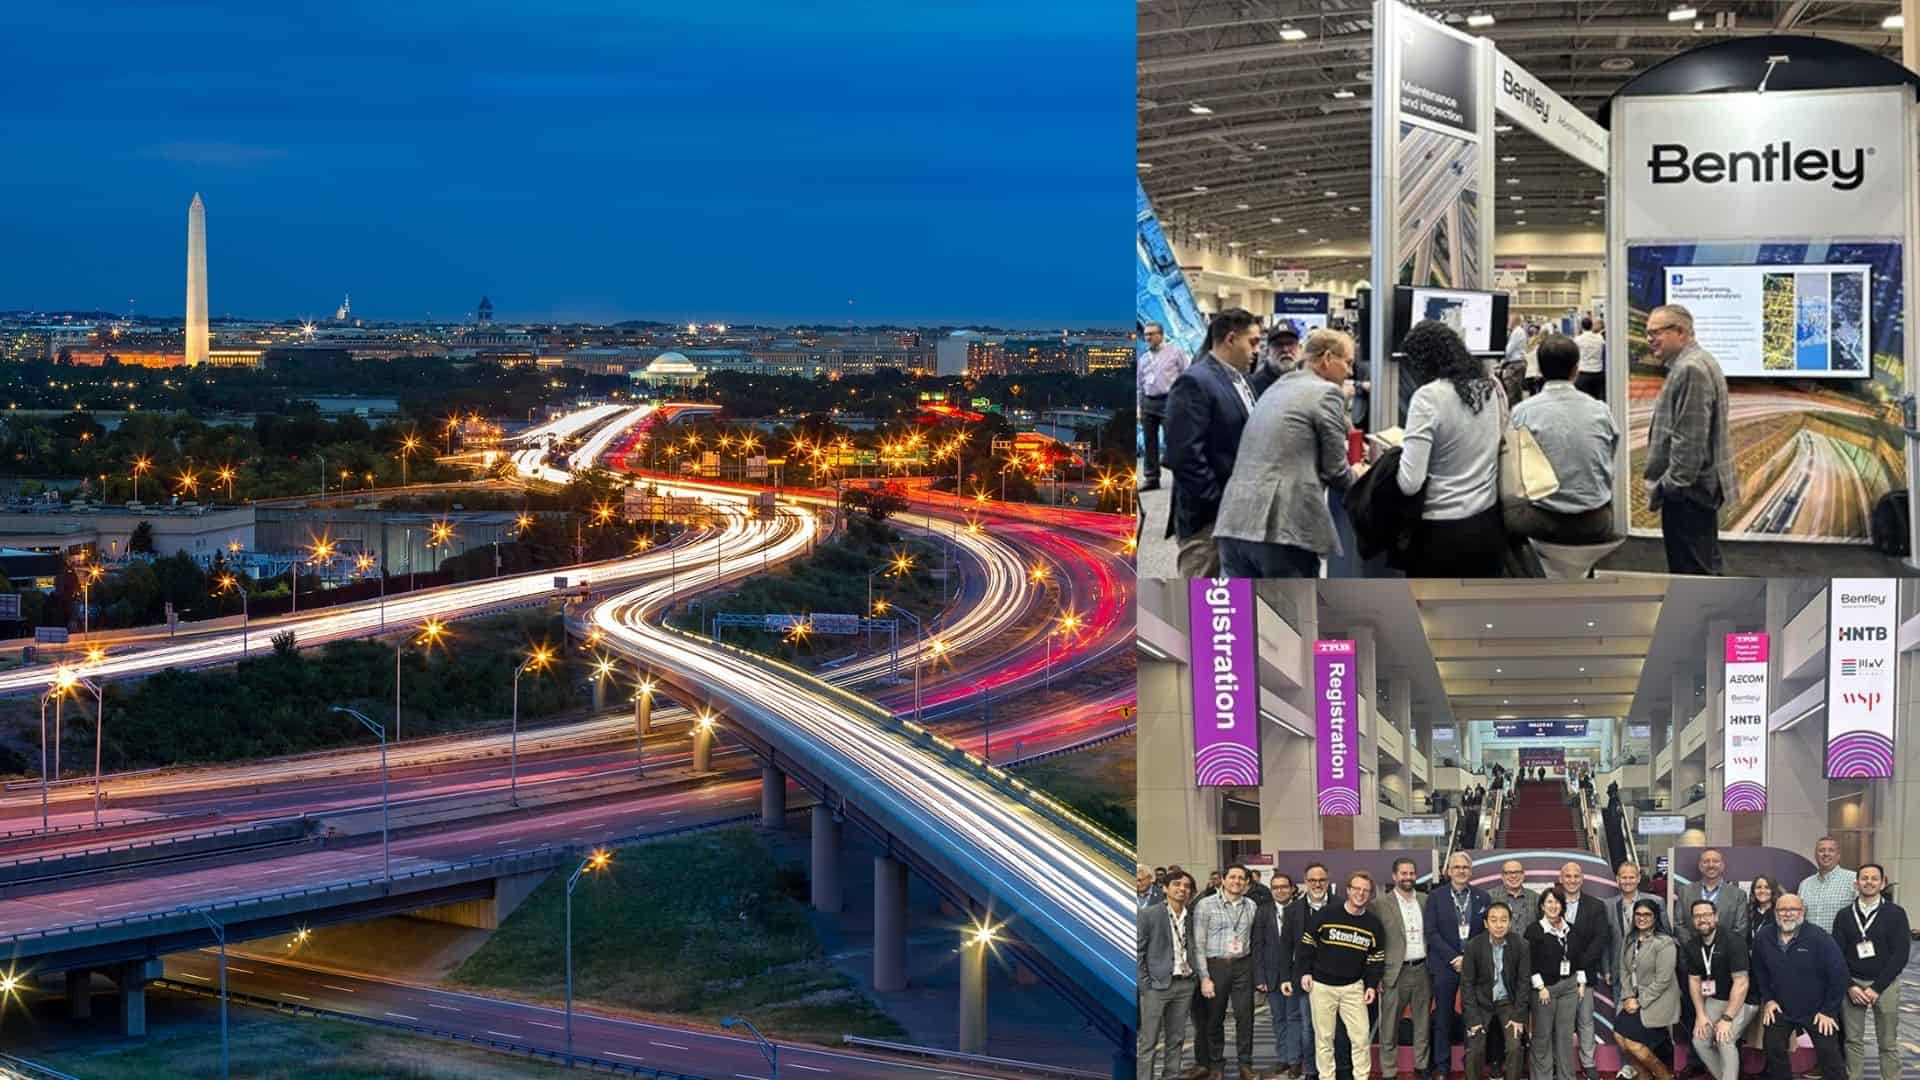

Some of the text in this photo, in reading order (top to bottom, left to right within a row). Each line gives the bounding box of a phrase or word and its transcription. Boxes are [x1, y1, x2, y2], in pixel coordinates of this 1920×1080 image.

[1401, 81, 1457, 108] Maintenance
[1503, 69, 1550, 124] Bentley
[1401, 96, 1464, 124] and inspection
[1648, 141, 1866, 190] Bentley
[1841, 593, 1886, 606] Bentley
[1838, 626, 1888, 641] HNTB
[1320, 643, 1350, 652] TRB
[1729, 674, 1764, 684] AECOM
[1843, 692, 1881, 712] wsp
[1326, 662, 1350, 780] Registration
[1729, 714, 1761, 725] HNTB
[1329, 928, 1371, 947] Steelers
